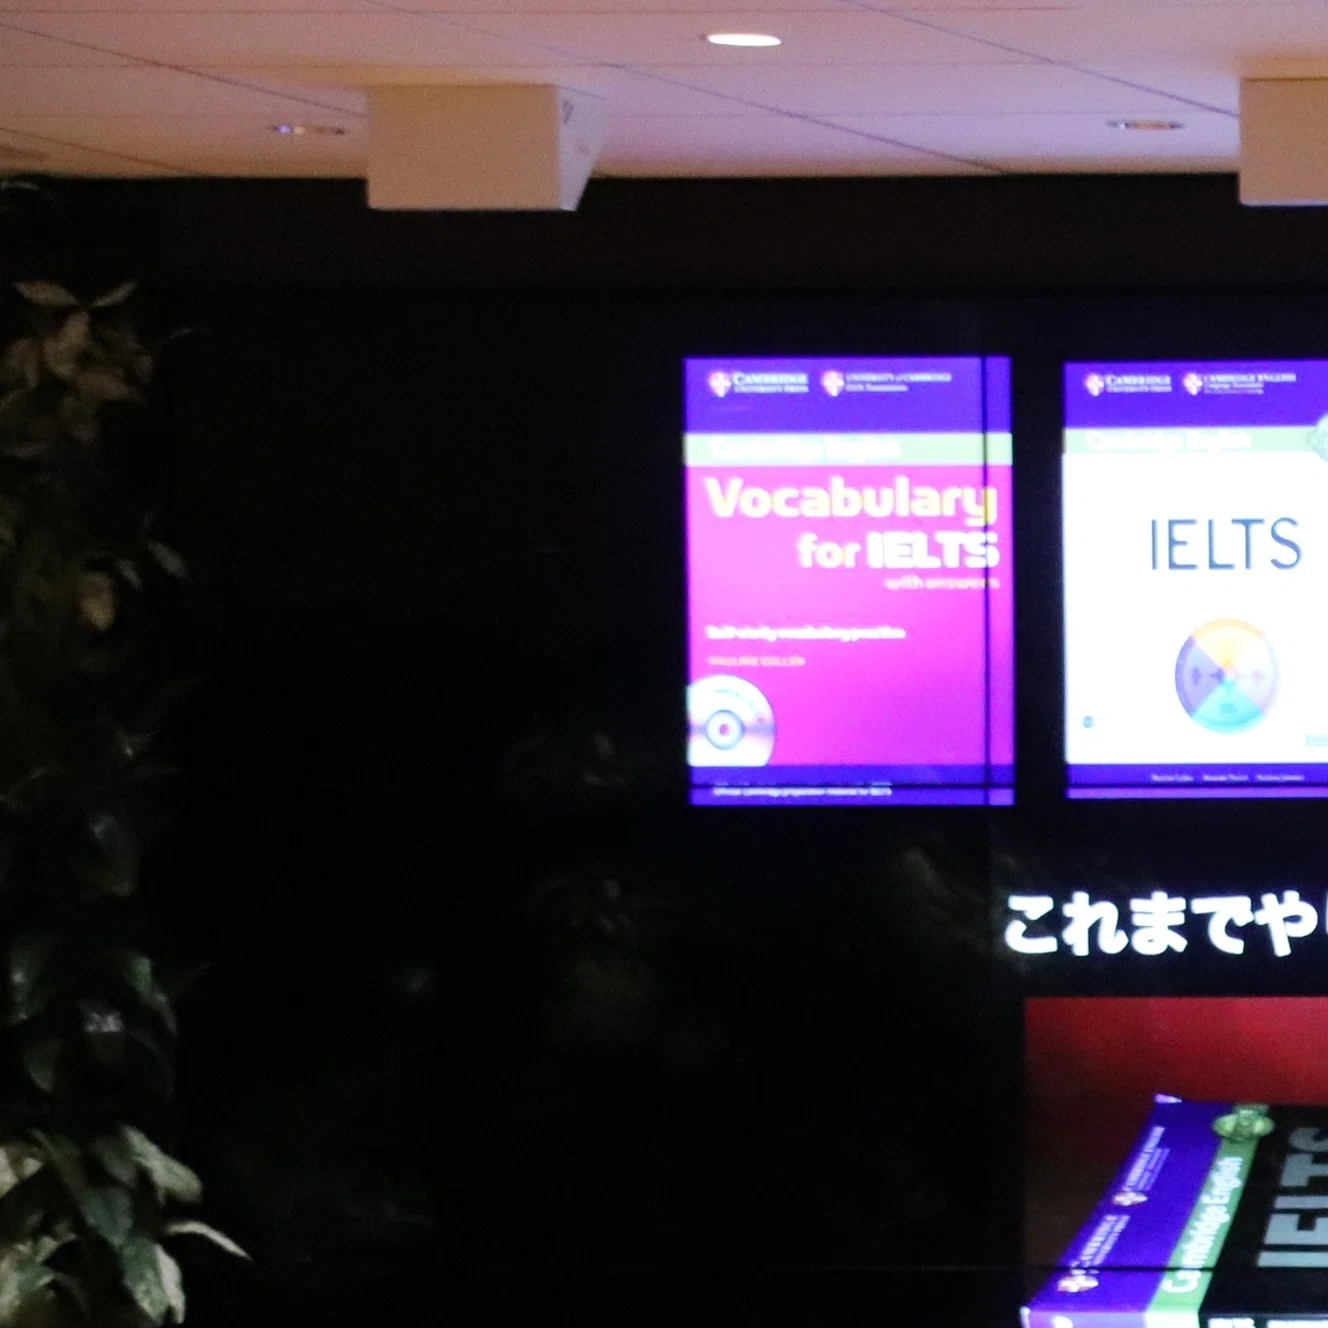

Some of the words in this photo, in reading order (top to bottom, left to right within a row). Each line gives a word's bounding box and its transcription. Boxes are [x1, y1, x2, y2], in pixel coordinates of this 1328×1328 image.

[704, 474, 998, 528] Vocabulary
[798, 532, 862, 569] for
[866, 530, 1001, 569] IELTS
[1151, 517, 1303, 571] IELTS
